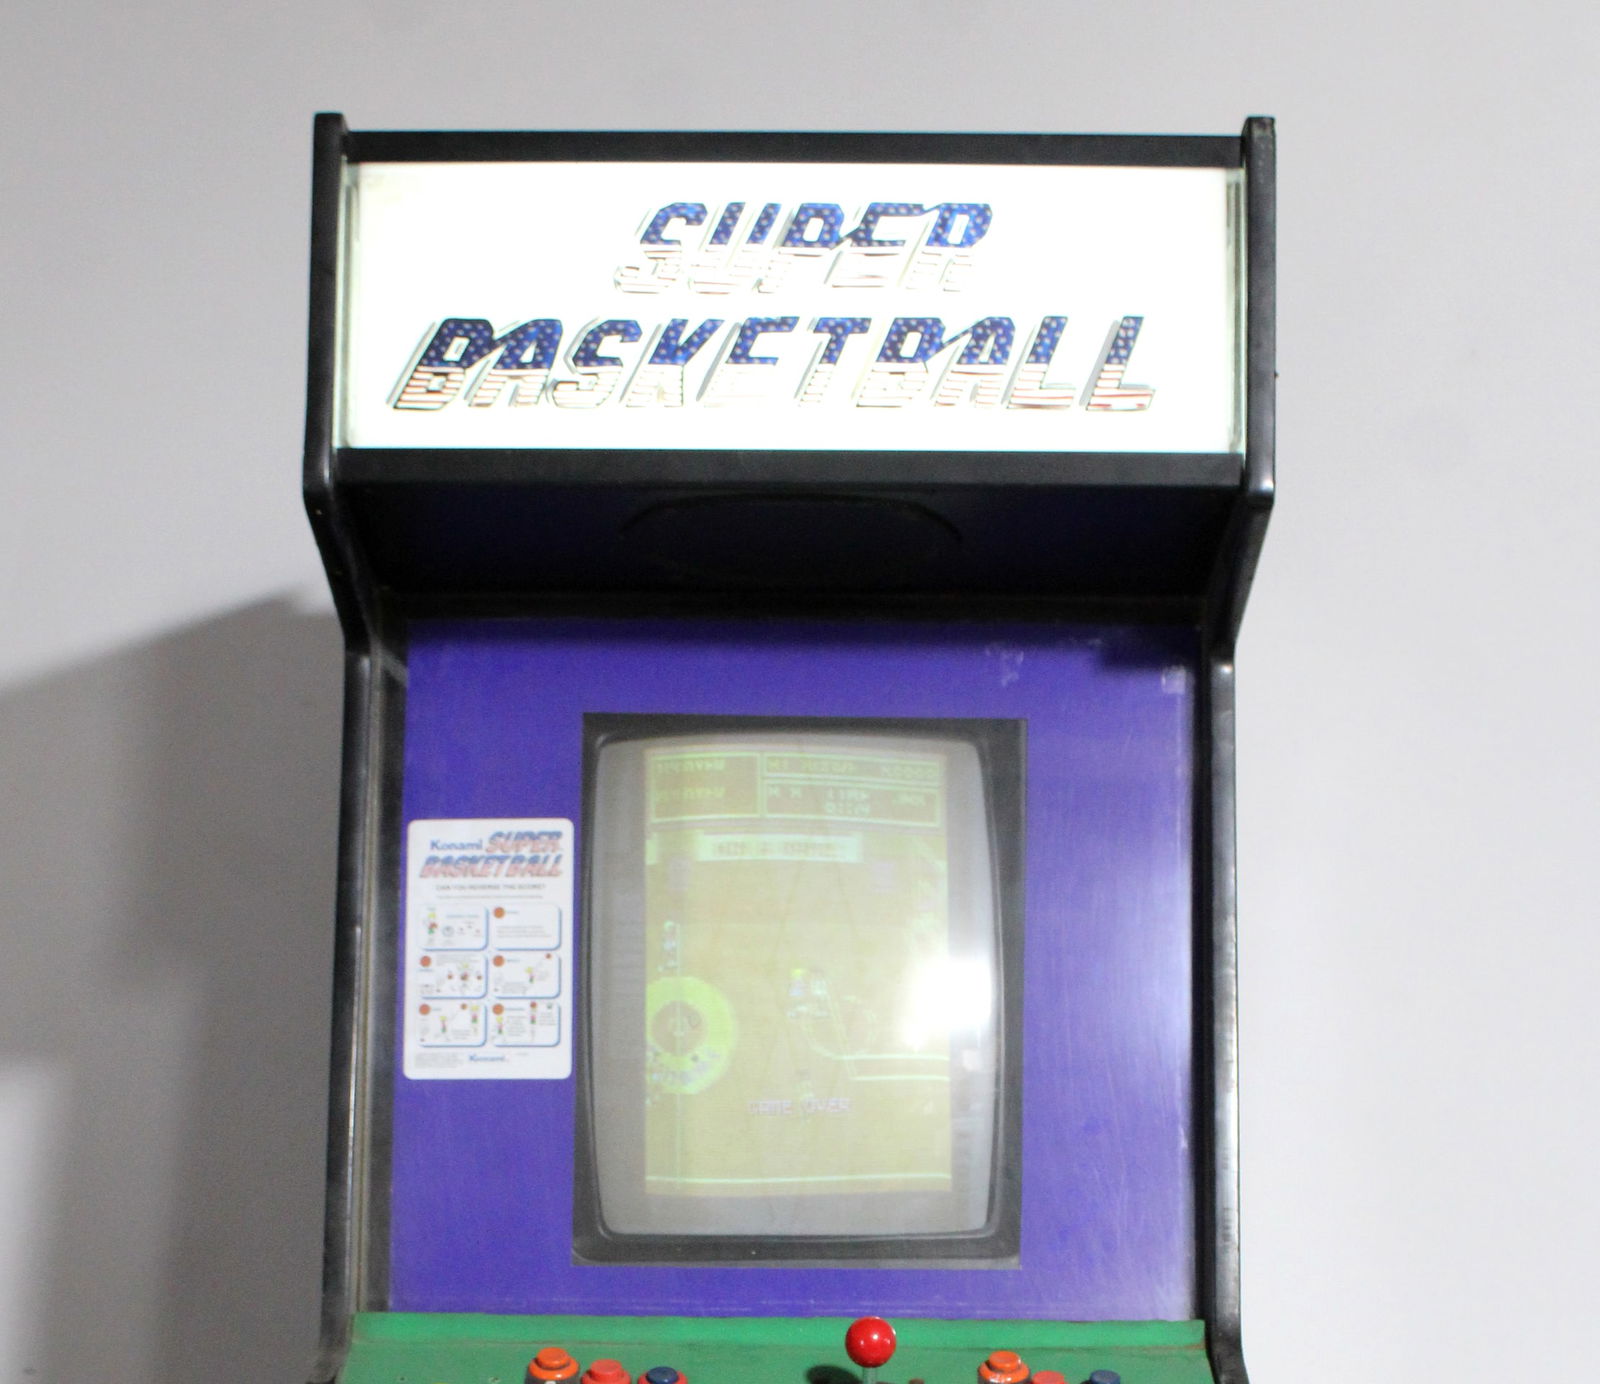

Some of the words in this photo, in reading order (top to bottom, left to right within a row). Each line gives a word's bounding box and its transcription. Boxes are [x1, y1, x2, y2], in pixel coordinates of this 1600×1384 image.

[614, 201, 994, 294] SUPER
[386, 315, 1157, 412] BASKETBALL
[418, 854, 564, 878] BASKETBALL
[429, 838, 483, 850] Konami
[484, 830, 564, 853] SUPER
